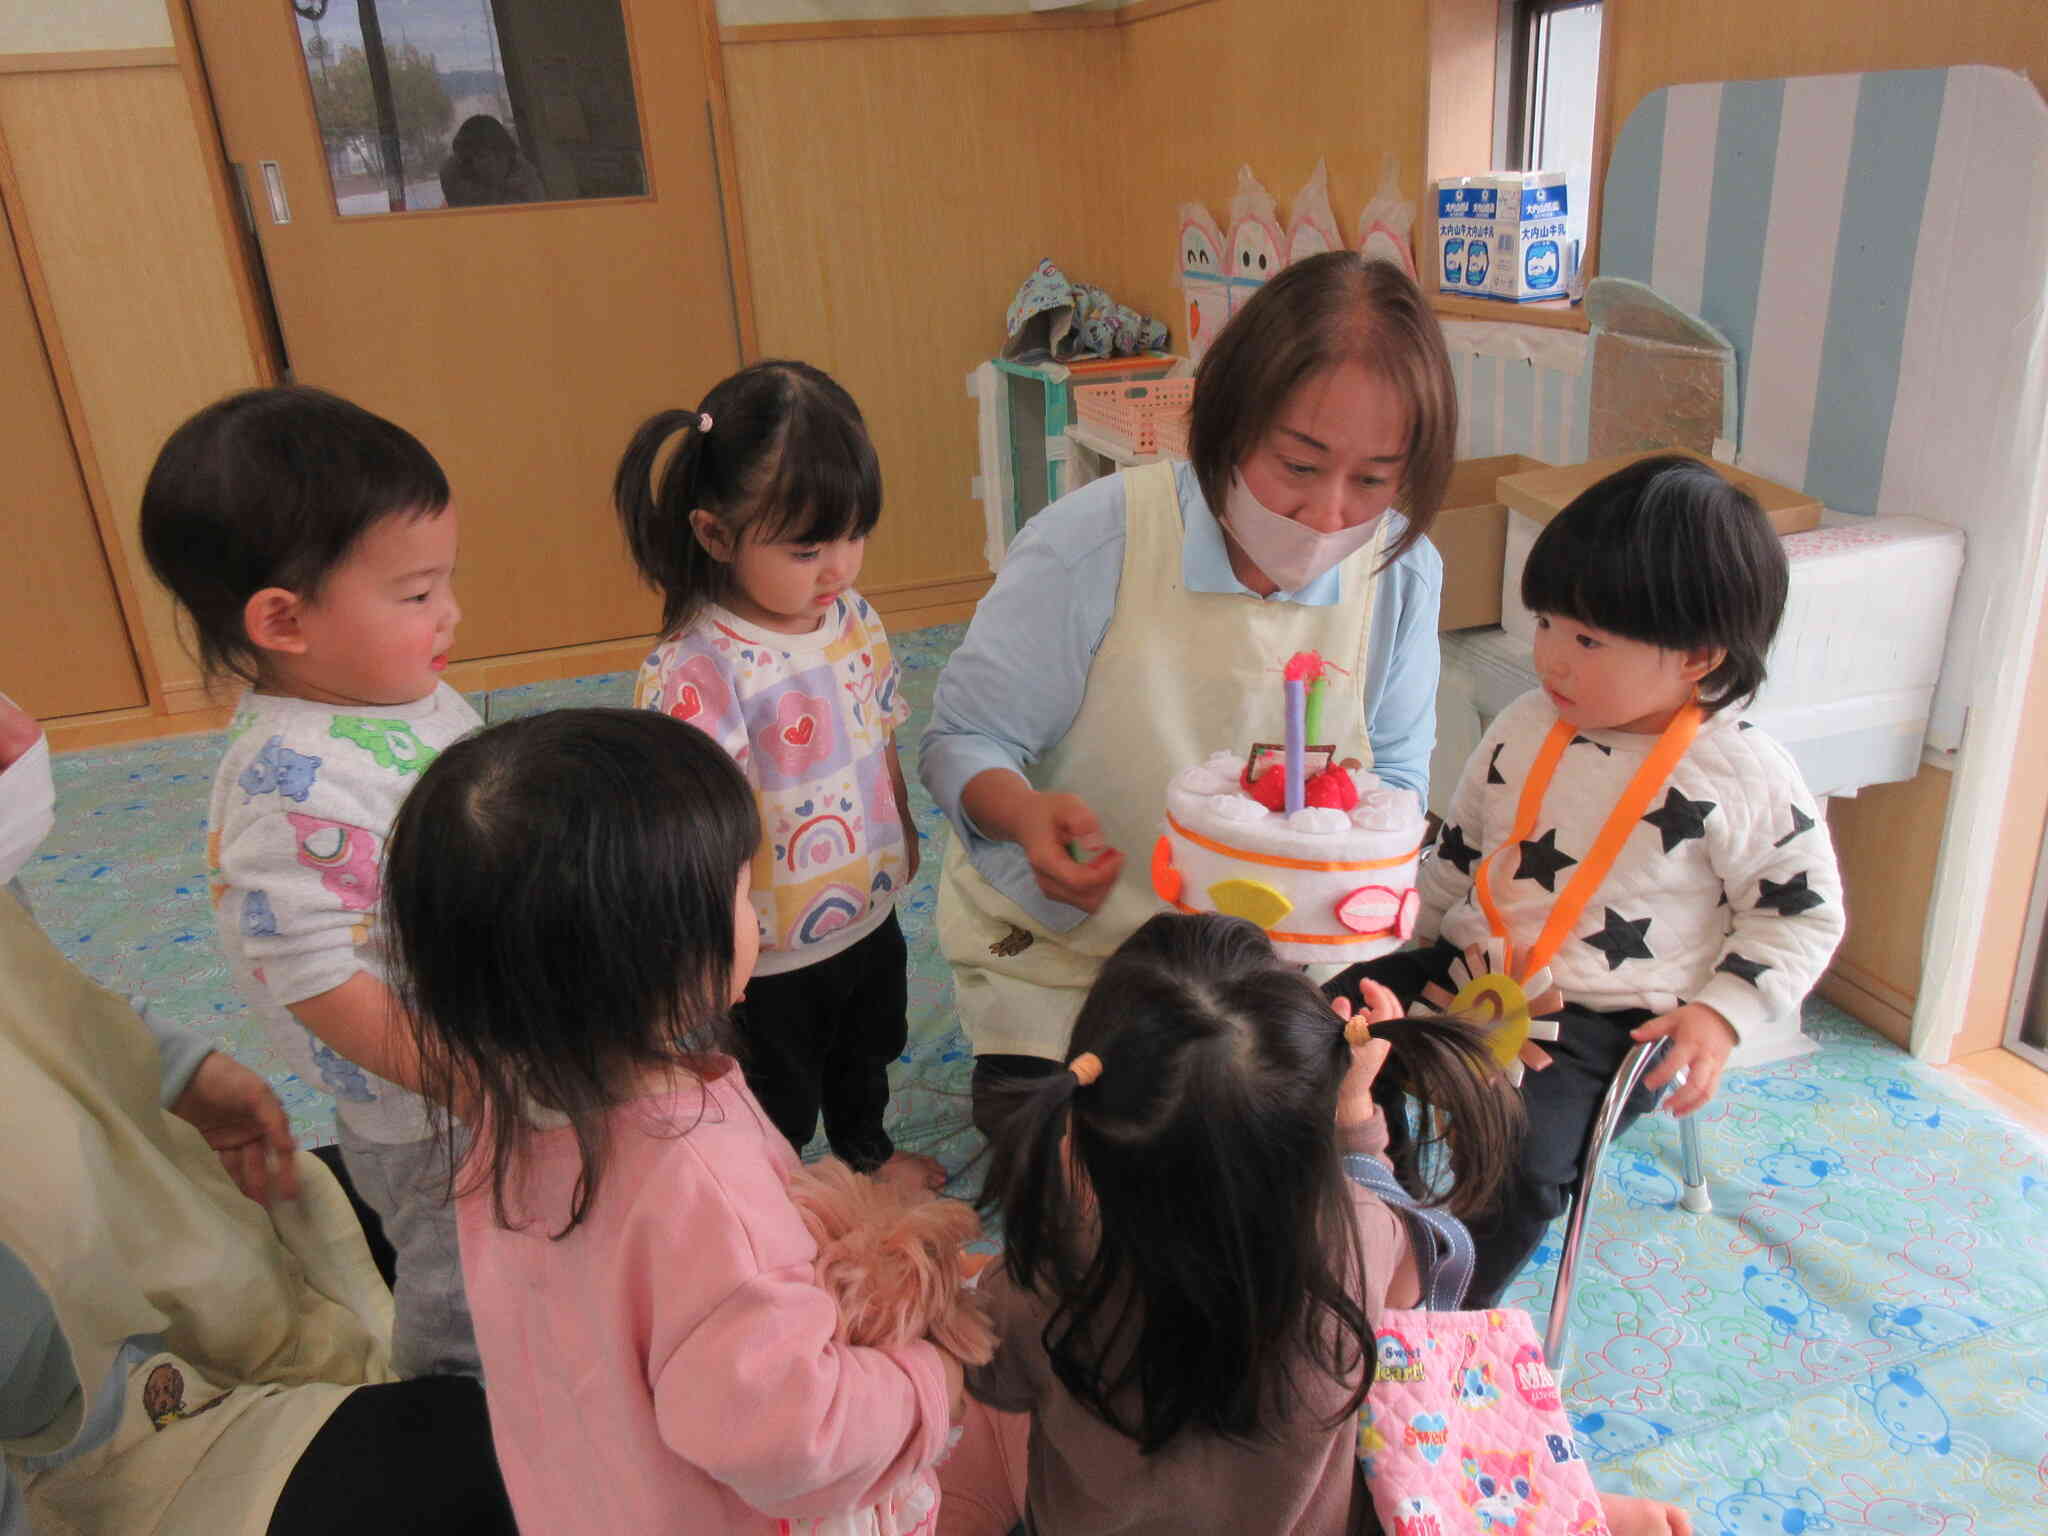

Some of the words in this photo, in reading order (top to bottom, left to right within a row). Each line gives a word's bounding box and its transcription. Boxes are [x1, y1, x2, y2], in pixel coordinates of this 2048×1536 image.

[1521, 224, 1566, 239] 大内山牛乳
